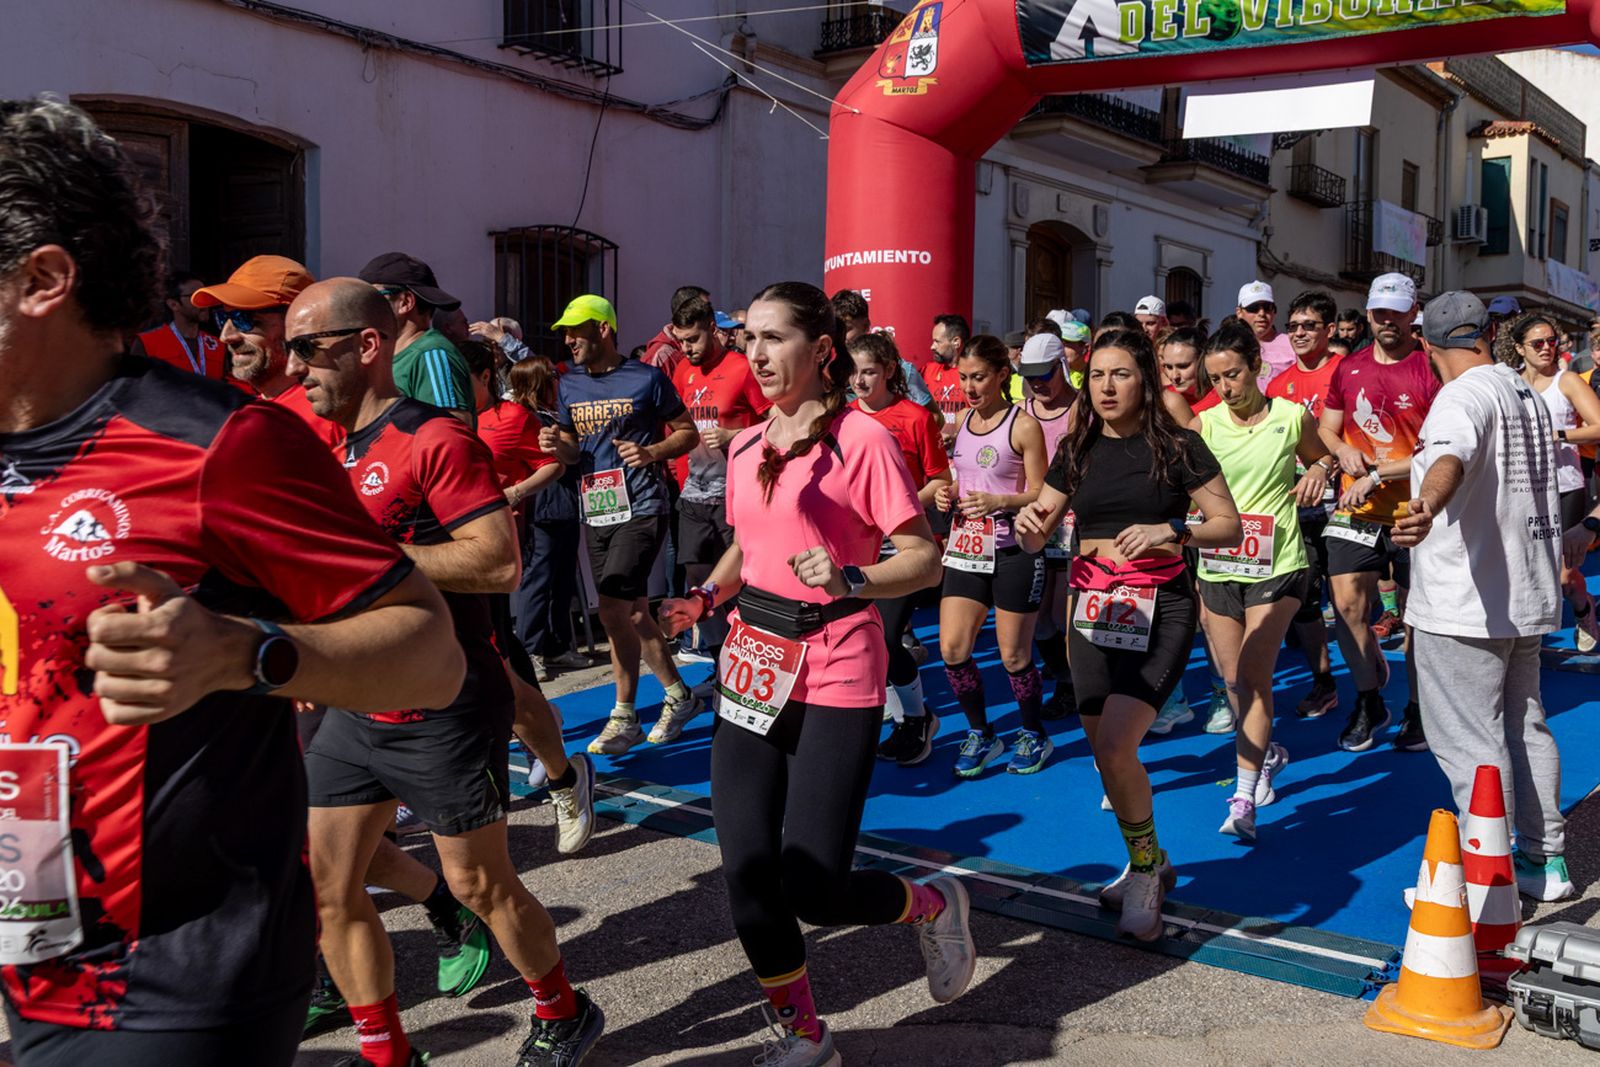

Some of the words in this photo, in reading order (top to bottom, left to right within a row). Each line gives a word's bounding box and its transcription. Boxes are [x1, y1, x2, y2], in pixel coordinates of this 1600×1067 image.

[1117, 0, 1211, 45] DEL
[851, 288, 871, 302] E
[1363, 418, 1379, 434] 43
[61, 488, 130, 539] CORRECAMINOS
[588, 490, 617, 511] 520
[43, 535, 115, 561] Martos
[954, 533, 983, 555] 428
[1086, 594, 1137, 624] 612
[732, 625, 745, 644] X
[741, 635, 785, 661] CROSS
[724, 652, 776, 702] 703
